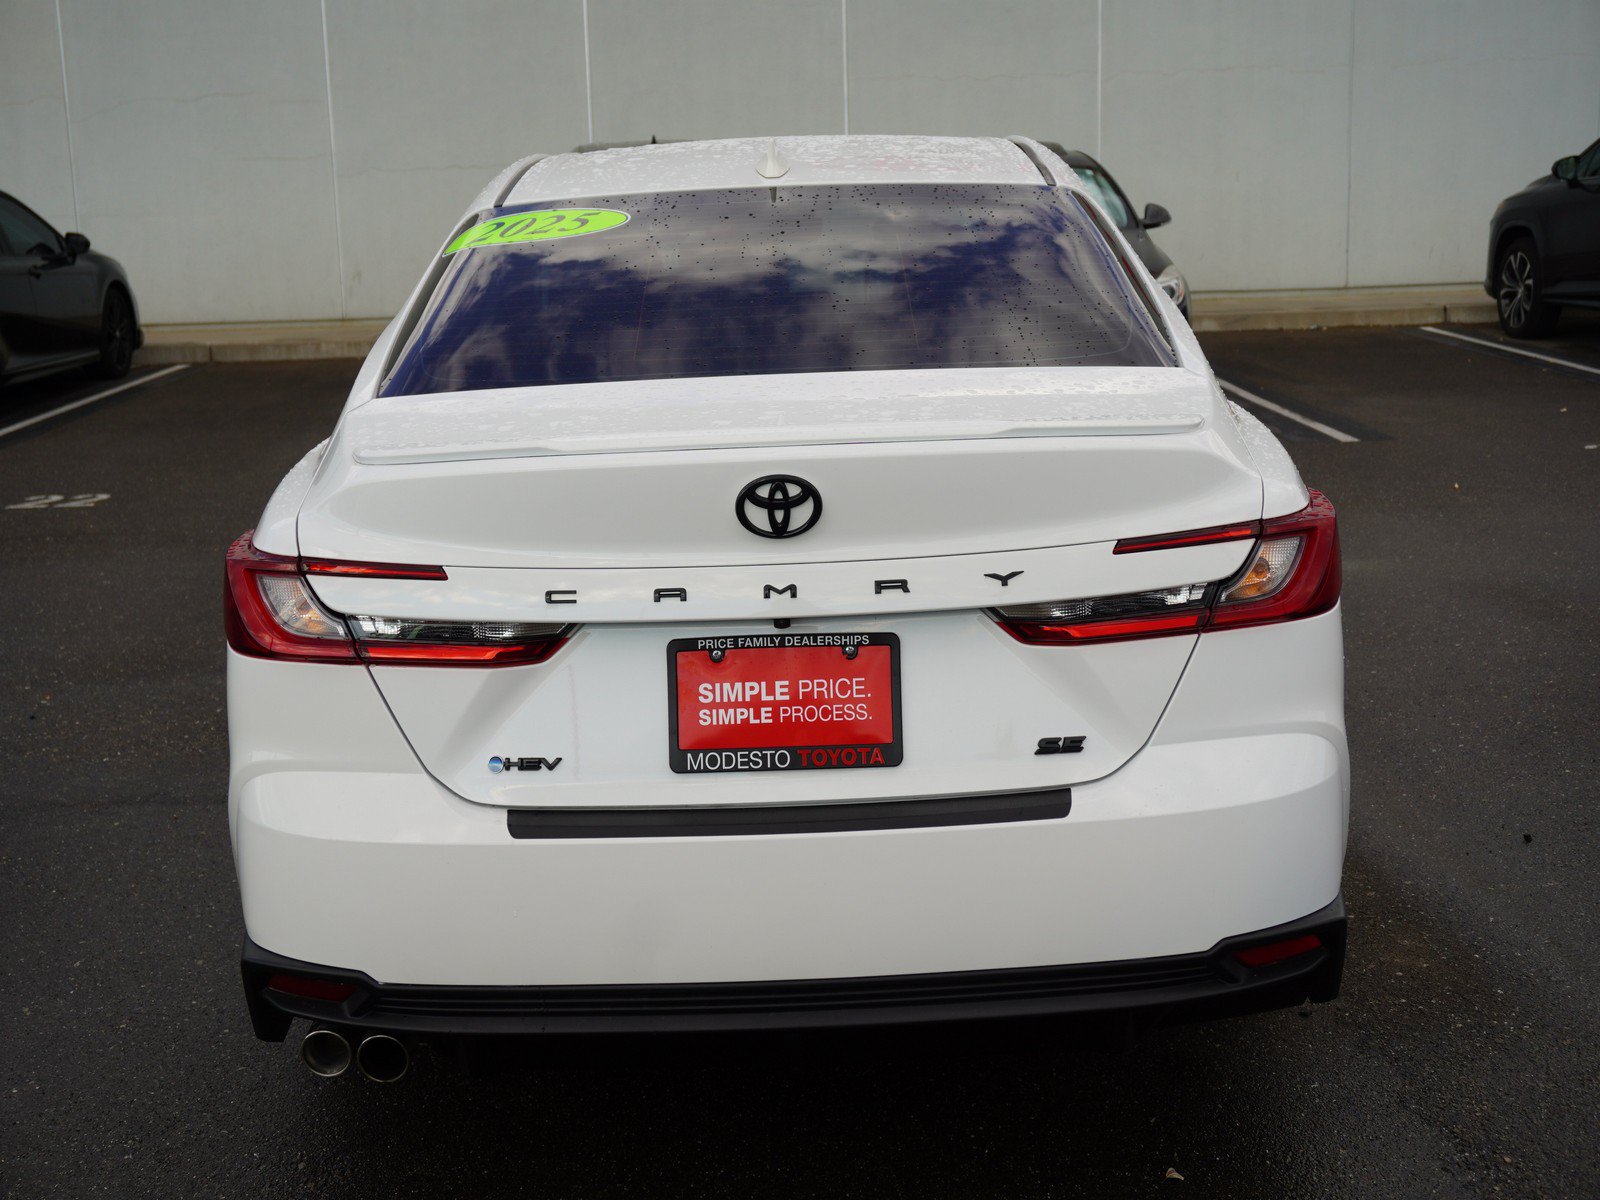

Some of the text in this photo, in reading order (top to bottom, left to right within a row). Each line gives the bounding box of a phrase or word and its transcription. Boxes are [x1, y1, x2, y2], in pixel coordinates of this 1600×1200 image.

[468, 211, 602, 244] 2025
[545, 571, 1024, 604] CAMRY
[697, 635, 869, 649] PRICE FAMILY DEALERSHIPS
[698, 677, 872, 703] SIMPLE PRICE.
[698, 703, 872, 725] SIMPLE PROCESS.
[1034, 735, 1087, 755] SE
[504, 757, 562, 771] HEV
[687, 747, 884, 770] MODESTO TOYOTA
